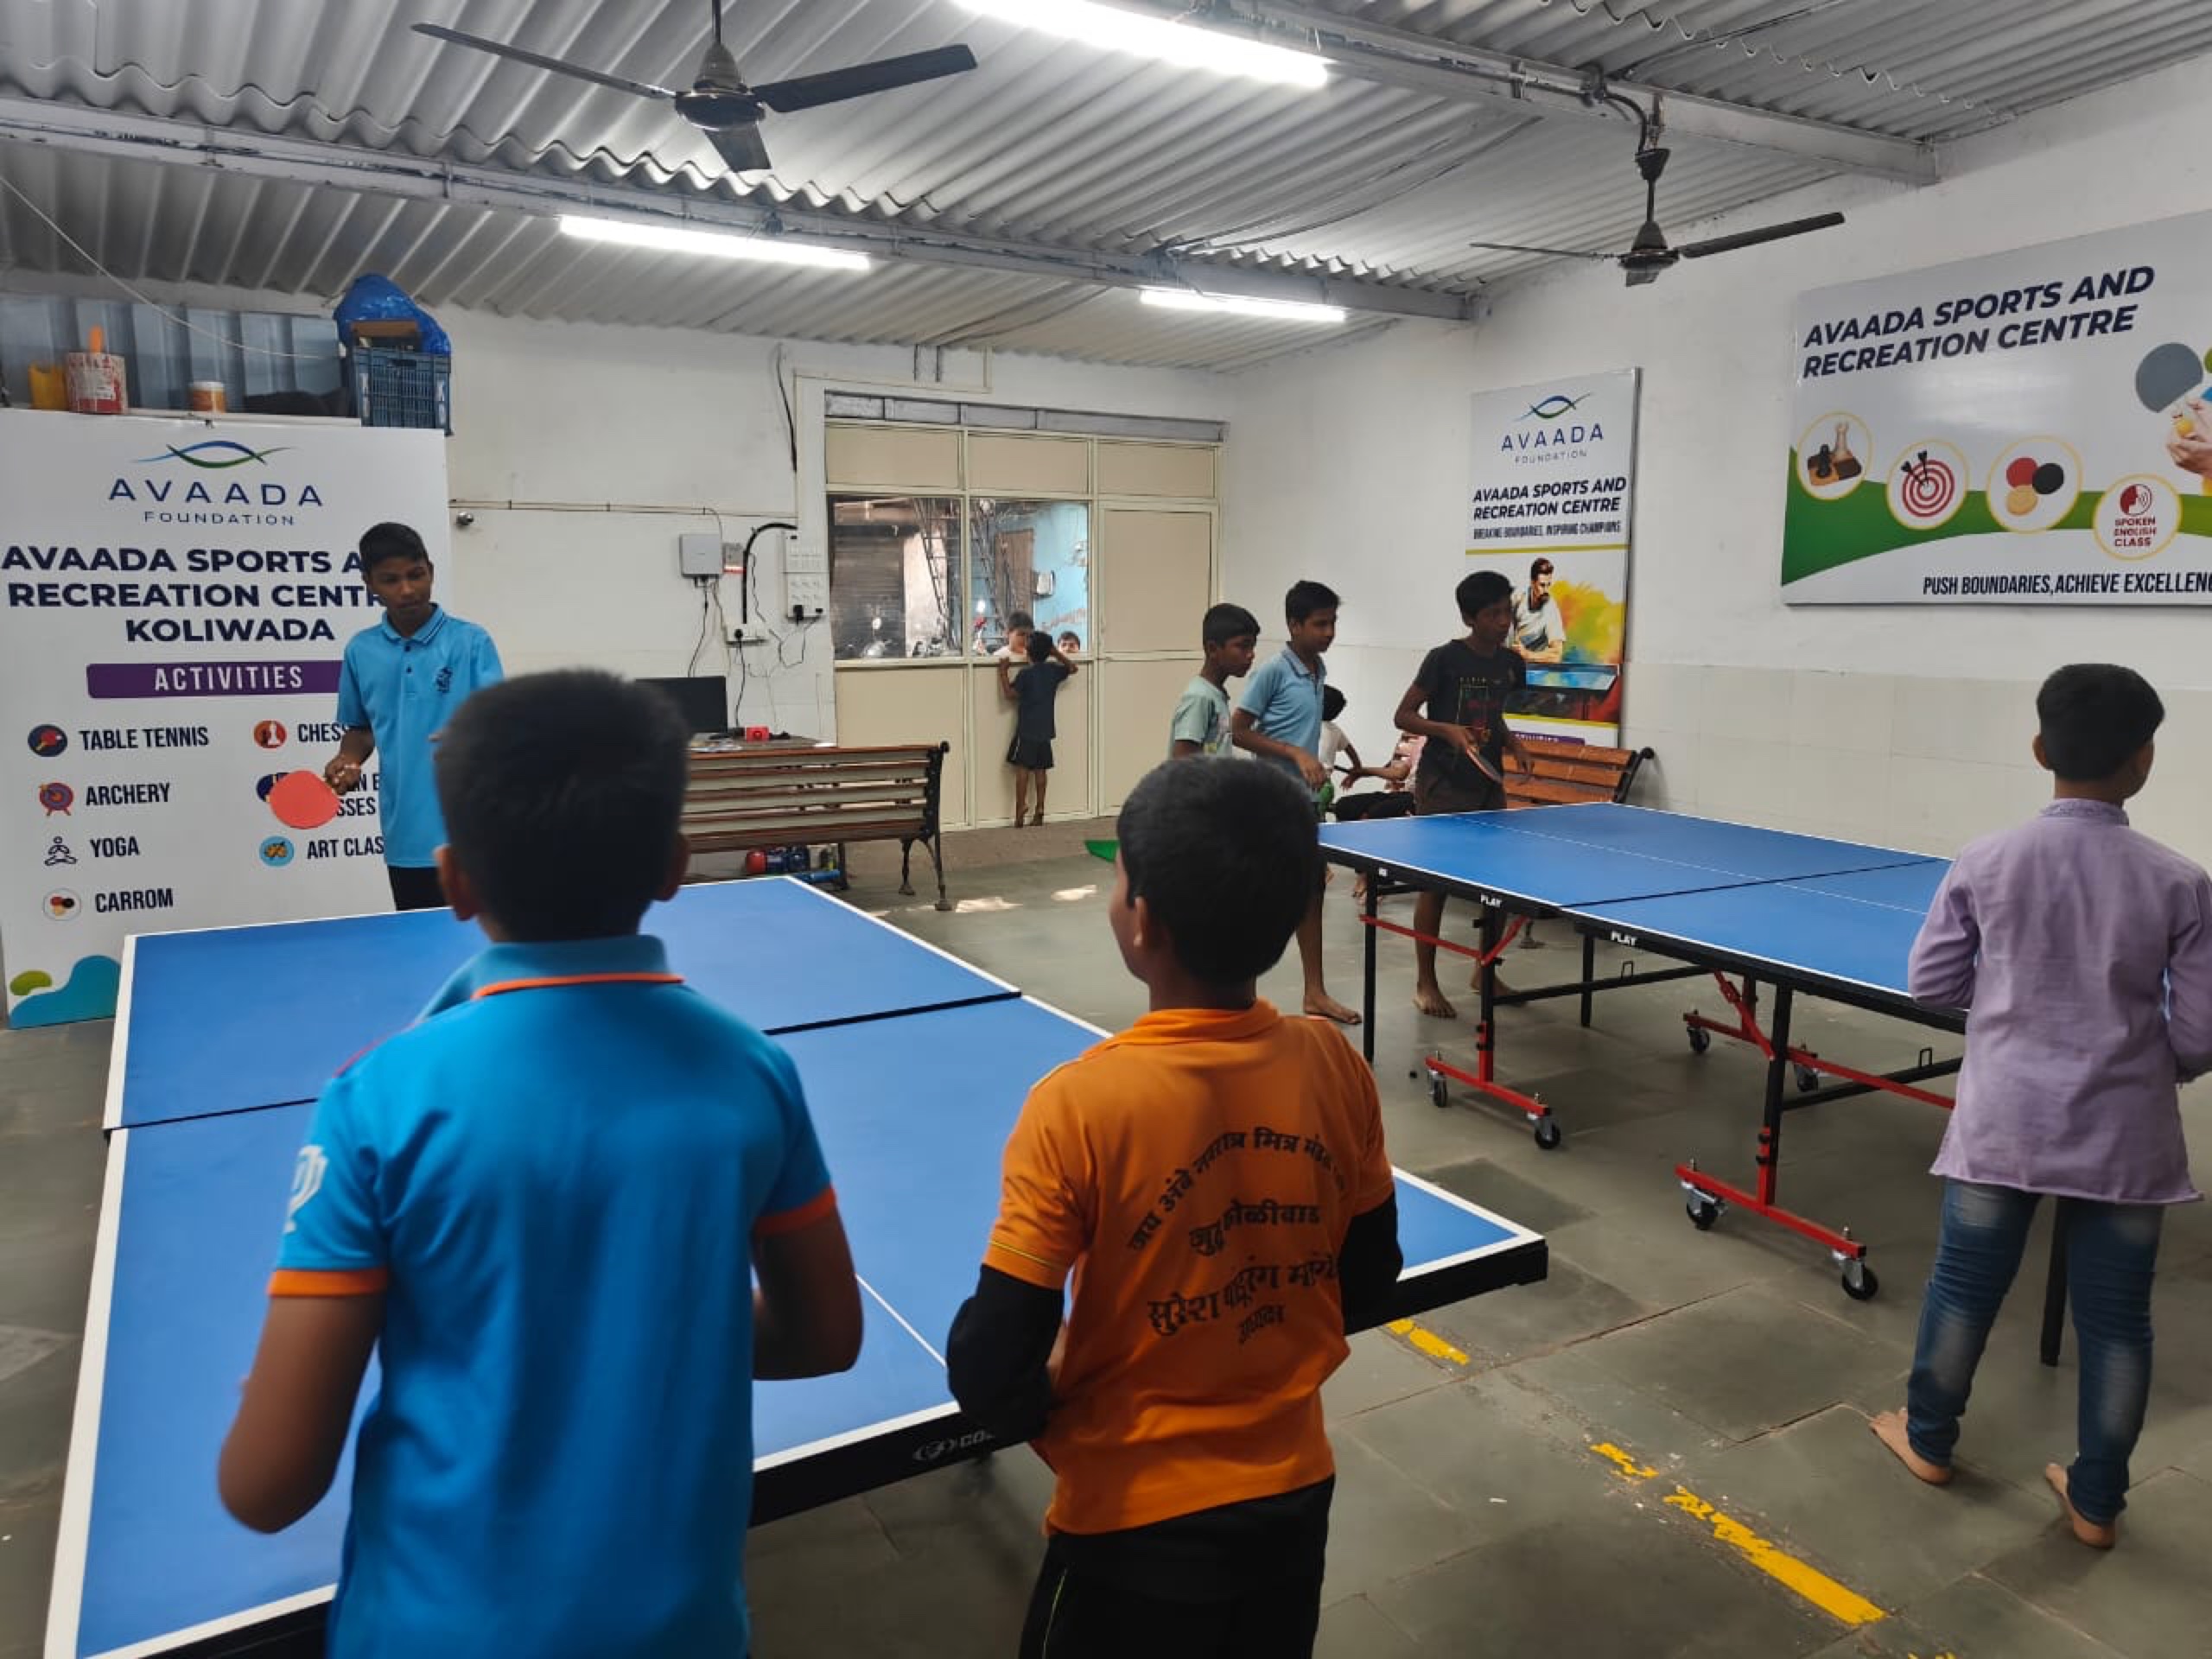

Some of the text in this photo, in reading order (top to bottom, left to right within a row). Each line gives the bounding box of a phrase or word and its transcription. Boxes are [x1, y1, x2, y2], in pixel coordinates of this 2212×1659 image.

[1803, 266, 2155, 347] AVAADA SPORTS AND
[1802, 304, 2139, 378] RECREATION CENTRE
[1501, 423, 1605, 451] AVAADA
[1515, 449, 1587, 464] FOUNDATION
[109, 478, 323, 507] AVAADA
[1472, 477, 1627, 502] AVAADA SPORTS AND
[144, 511, 294, 526] FOUNDATION
[1473, 498, 1621, 520] RECREATION CENTRE
[2113, 527, 2157, 537] ENGLISH
[2114, 517, 2156, 526] SPOKEN
[2114, 537, 2152, 547] CLASS
[1, 545, 177, 572] AVAADA
[187, 549, 331, 573] SPORTS
[8, 583, 259, 607] RECREATION
[1923, 575, 1958, 595] PUSH
[125, 618, 335, 642] KOLIWADA
[155, 665, 303, 690] ACTIVITIES
[79, 727, 209, 751] TABLE TENNIS
[86, 783, 170, 806] ARCHERY
[90, 836, 140, 858] YOGA
[307, 836, 385, 860] ART CLAS
[95, 889, 174, 913] CARROM
